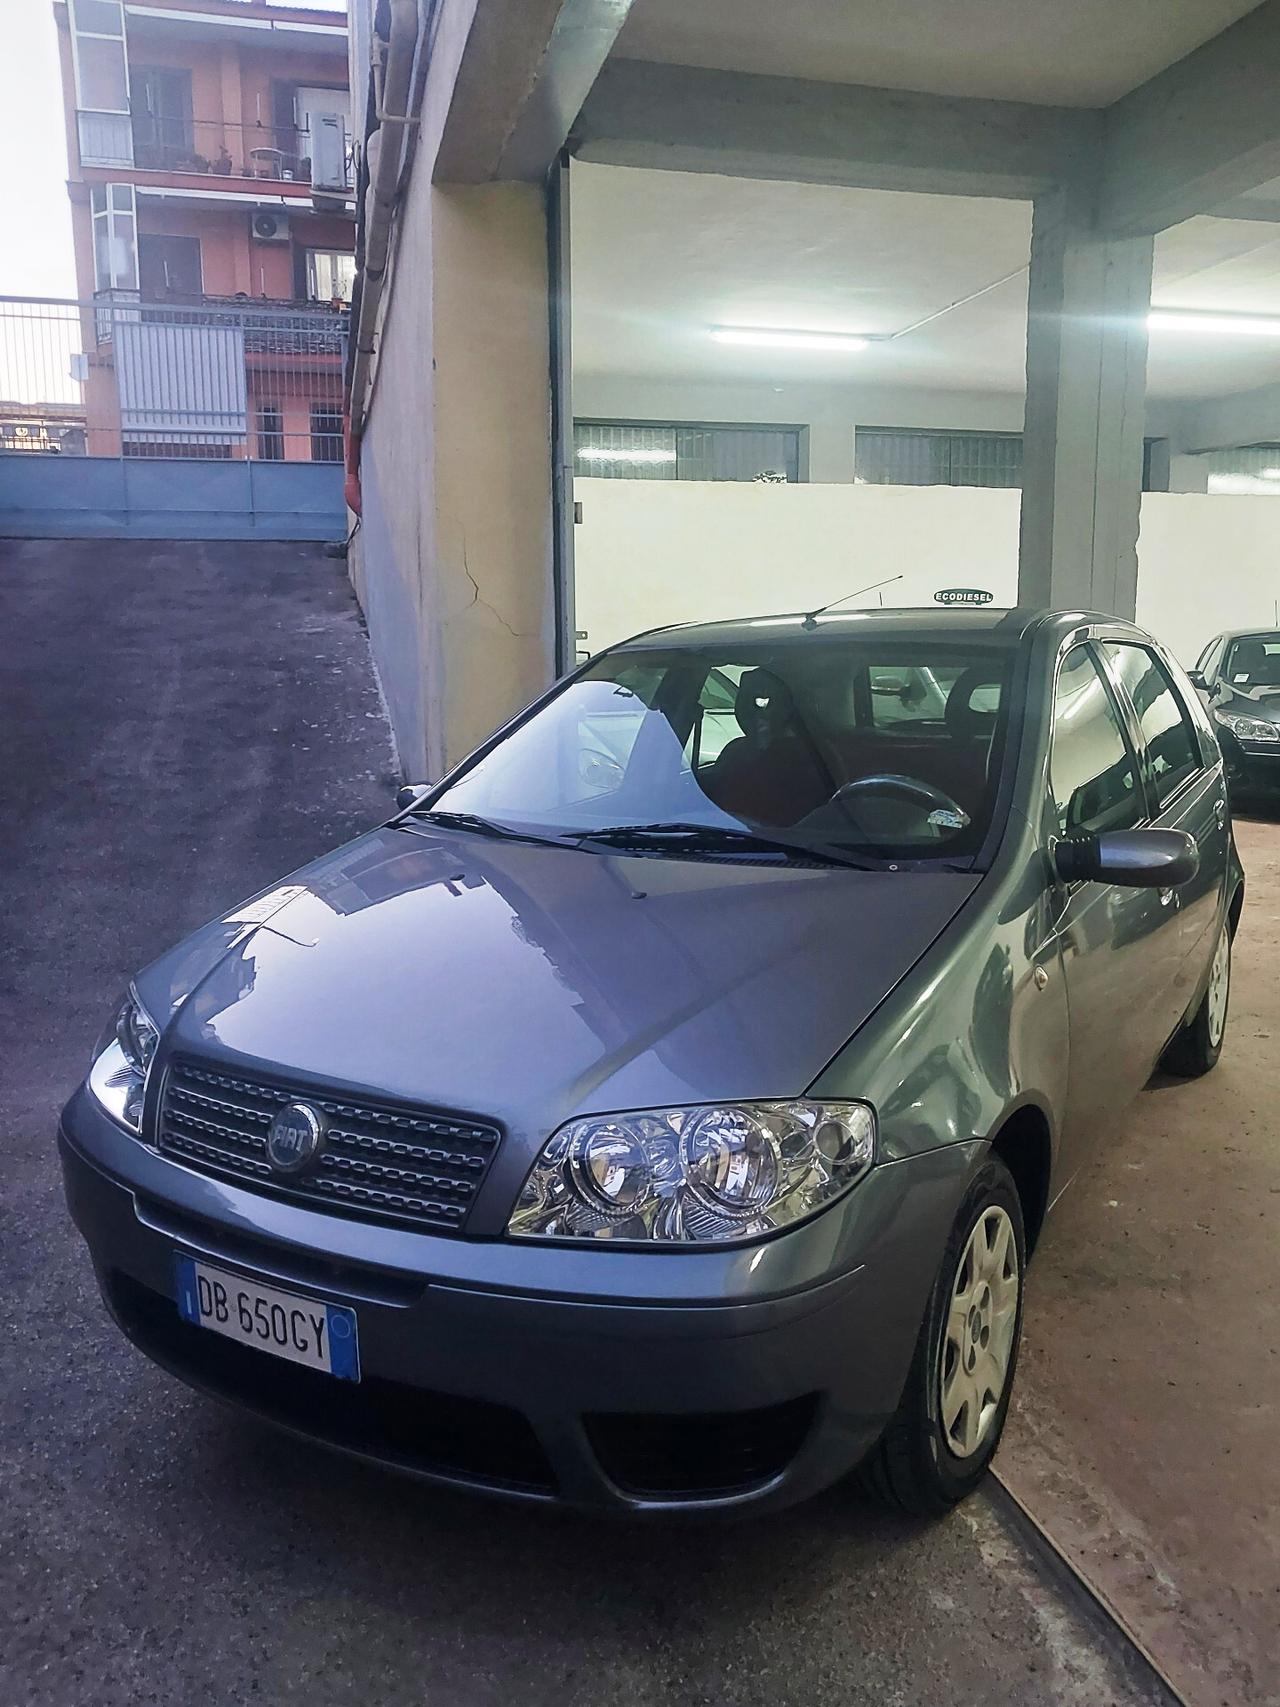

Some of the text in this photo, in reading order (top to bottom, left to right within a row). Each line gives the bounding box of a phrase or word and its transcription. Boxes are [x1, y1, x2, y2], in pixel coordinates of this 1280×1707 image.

[935, 593, 992, 602] ECODIESEL
[272, 1124, 308, 1152] FIAT
[198, 1275, 325, 1359] DB 650GY
